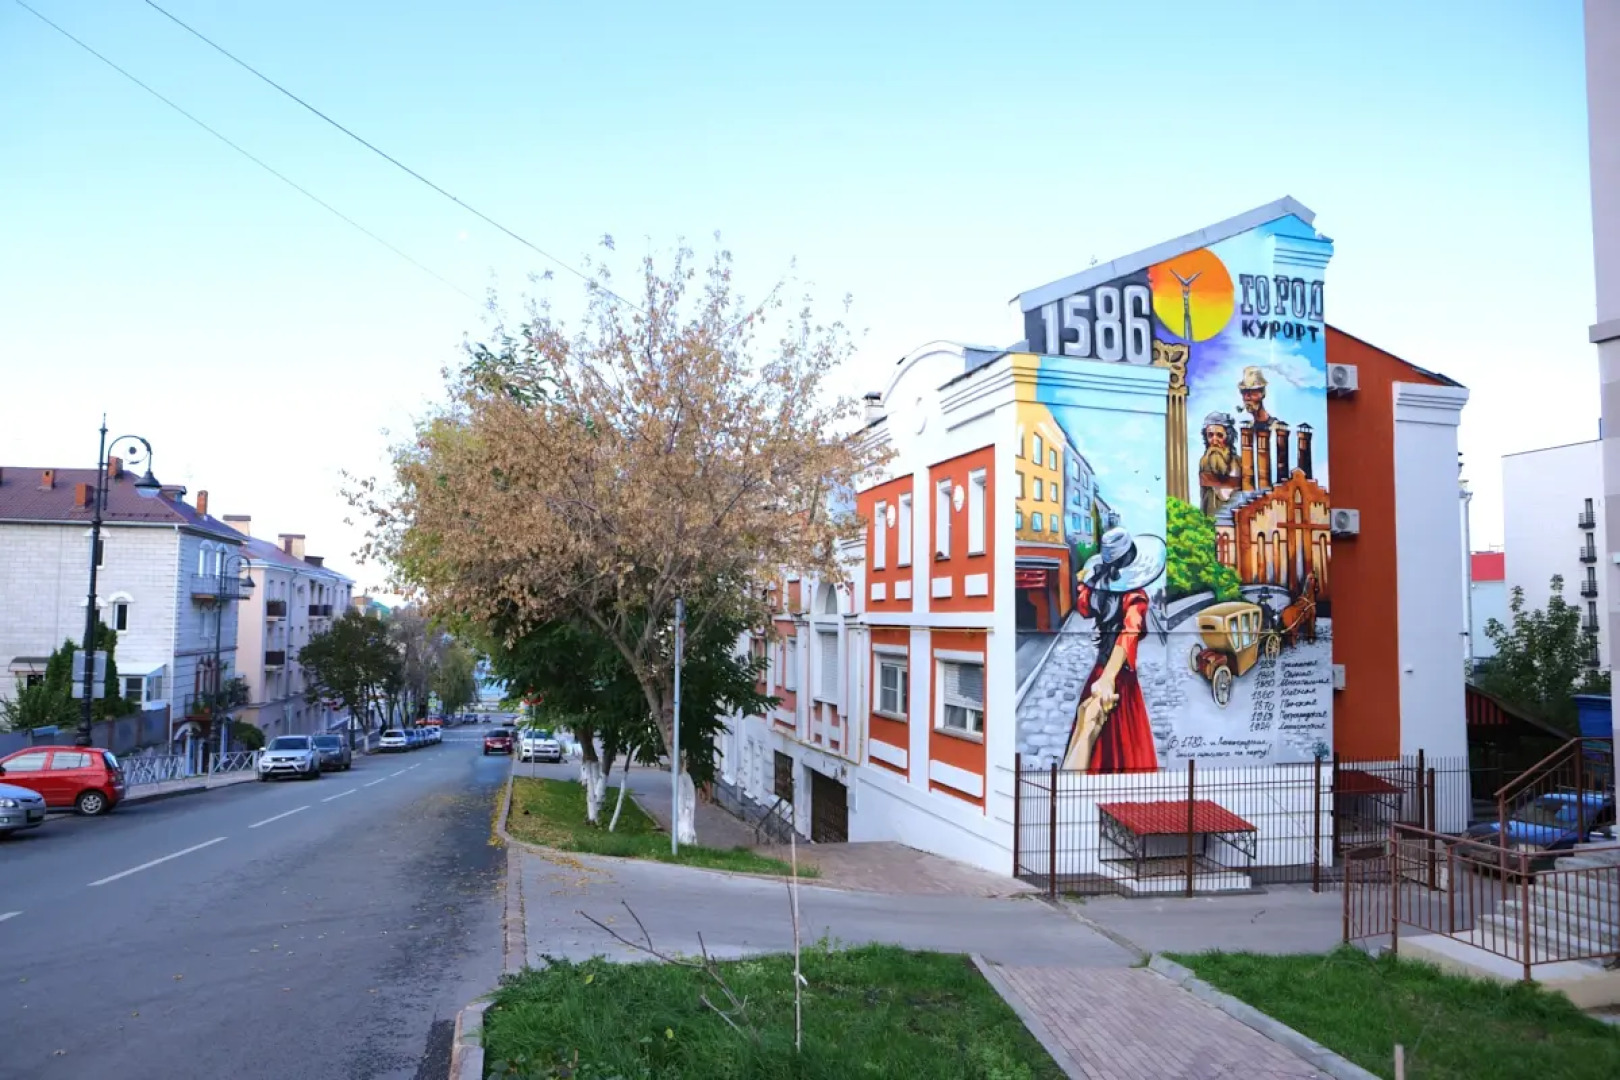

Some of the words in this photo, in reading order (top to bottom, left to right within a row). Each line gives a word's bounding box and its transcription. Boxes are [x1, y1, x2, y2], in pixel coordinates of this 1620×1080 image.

[1238, 273, 1325, 323] ГОРОД
[1042, 284, 1152, 364] 1586
[1241, 318, 1320, 343] КУРОРТ
[1253, 700, 1275, 711] 1870
